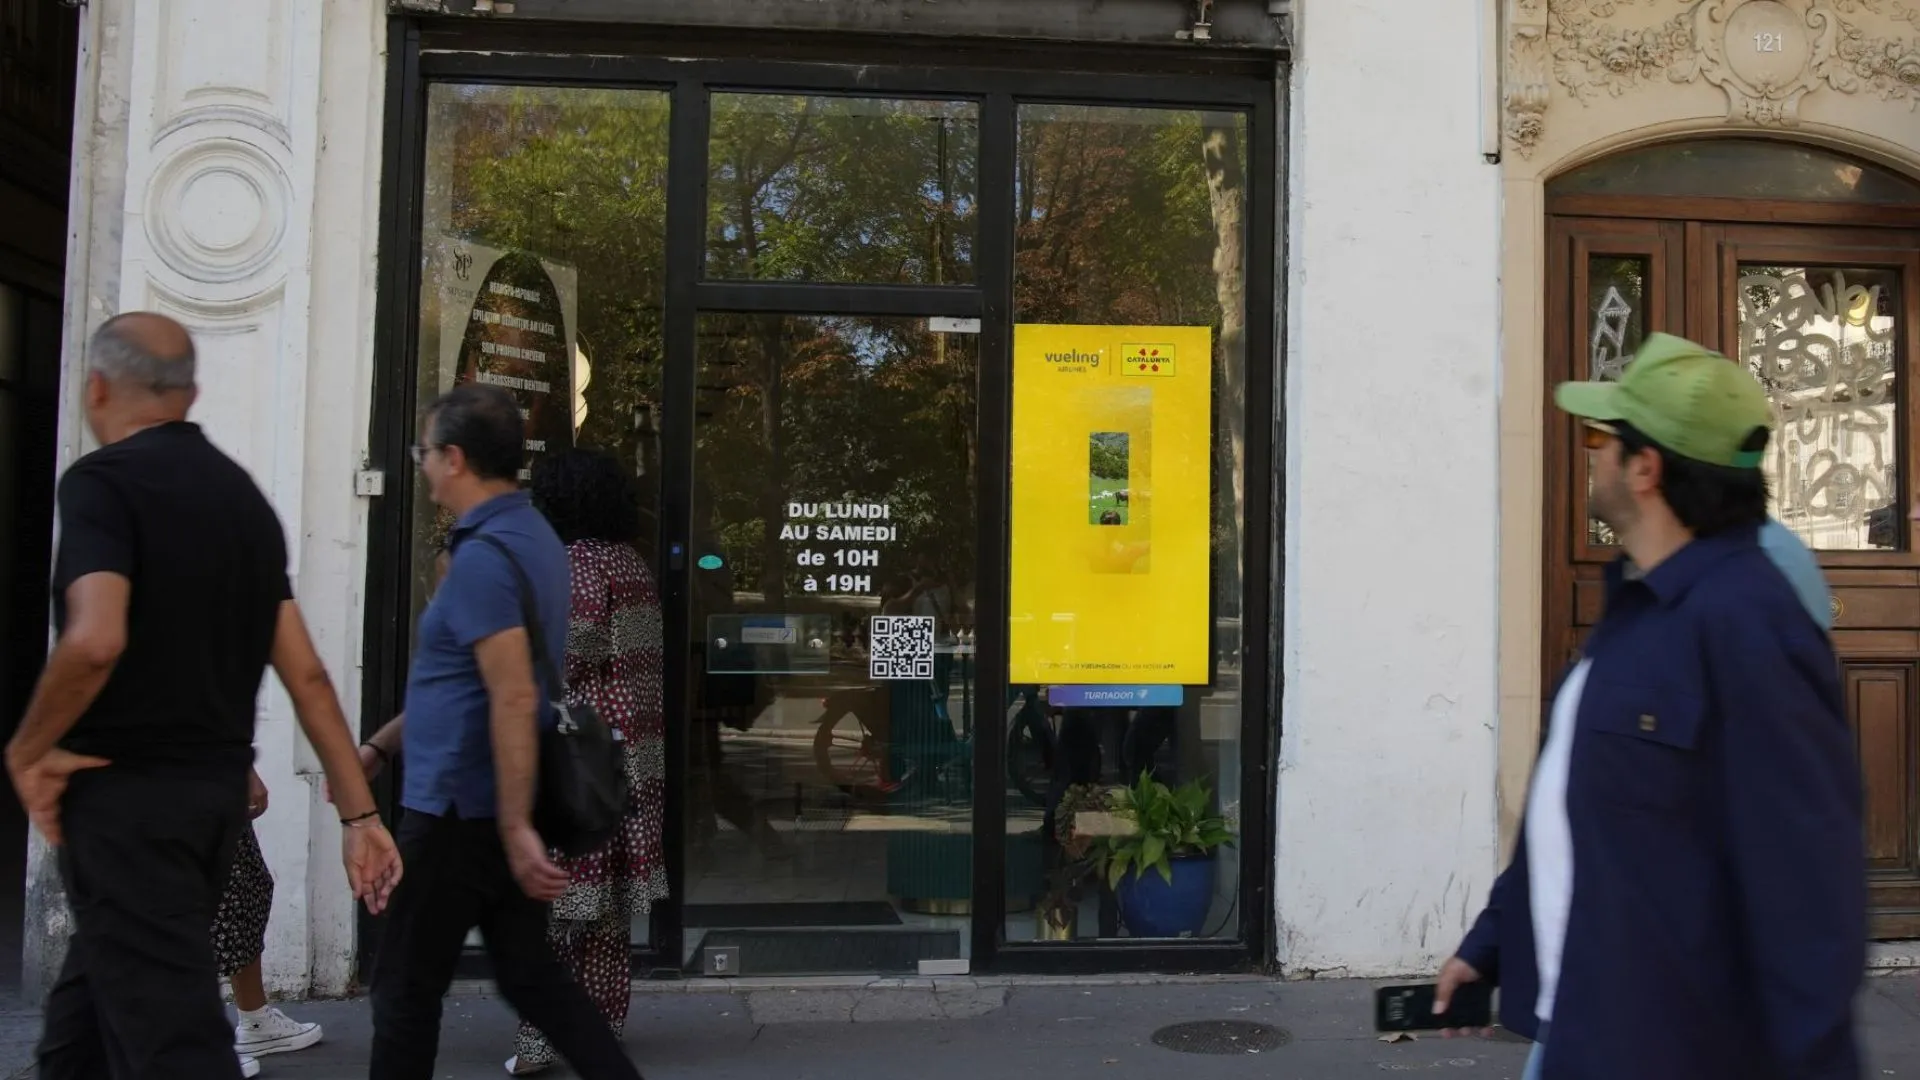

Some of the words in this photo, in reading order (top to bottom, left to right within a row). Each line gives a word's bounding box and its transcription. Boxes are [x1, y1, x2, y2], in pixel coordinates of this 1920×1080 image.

[1753, 33, 1782, 52] 121
[1045, 348, 1099, 367] vueling
[1127, 356, 1170, 364] CATALUNYA
[526, 440, 546, 452] CORPS
[788, 502, 817, 519] DU
[825, 503, 889, 520] LUNDI
[780, 525, 809, 541] AU
[816, 525, 897, 542] SAMEDI
[796, 549, 826, 567] de
[833, 549, 879, 567] 10H
[803, 574, 818, 592] à
[826, 575, 871, 593] 19H
[1083, 691, 1134, 701] TURNADON
